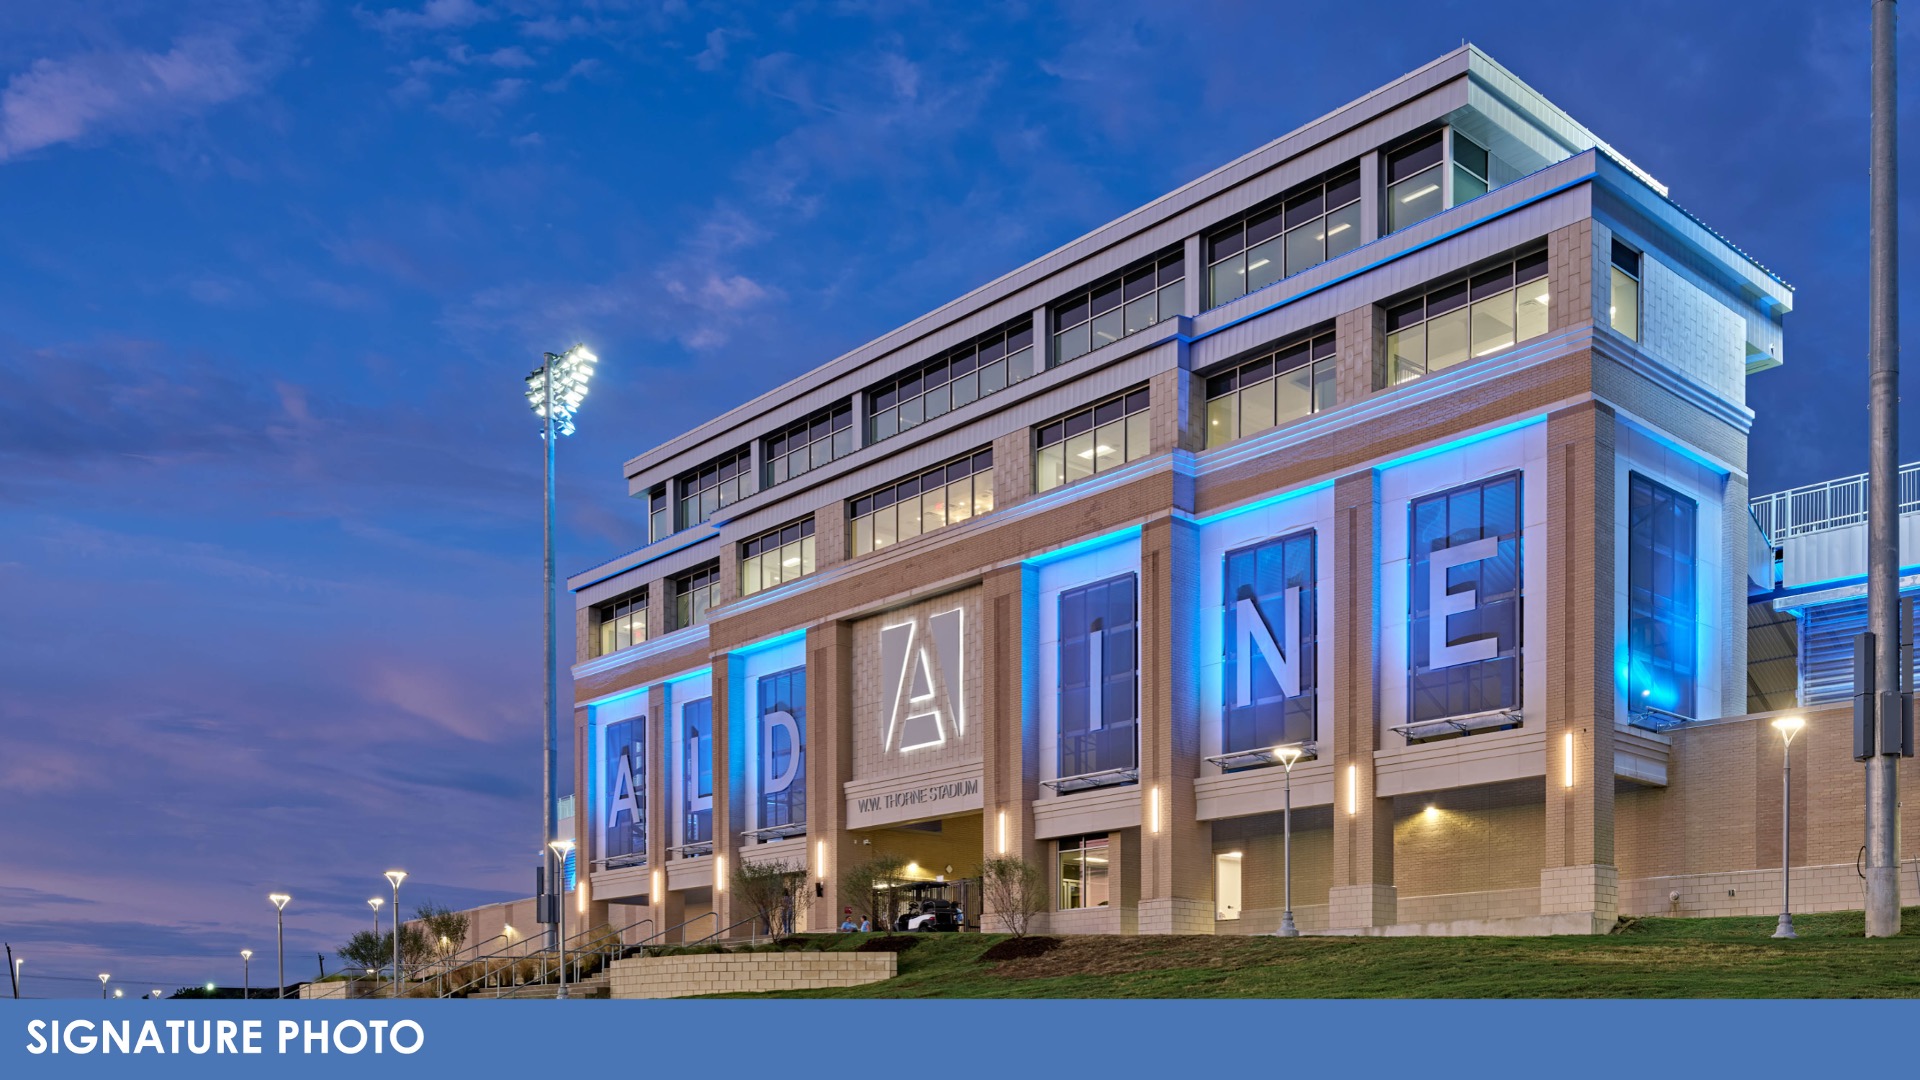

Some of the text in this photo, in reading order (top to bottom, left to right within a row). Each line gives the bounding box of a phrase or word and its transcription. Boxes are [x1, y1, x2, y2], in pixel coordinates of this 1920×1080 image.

[1236, 586, 1300, 708] N
[1429, 536, 1499, 670] E
[858, 780, 978, 813] W.W. THORNE STADIUM
